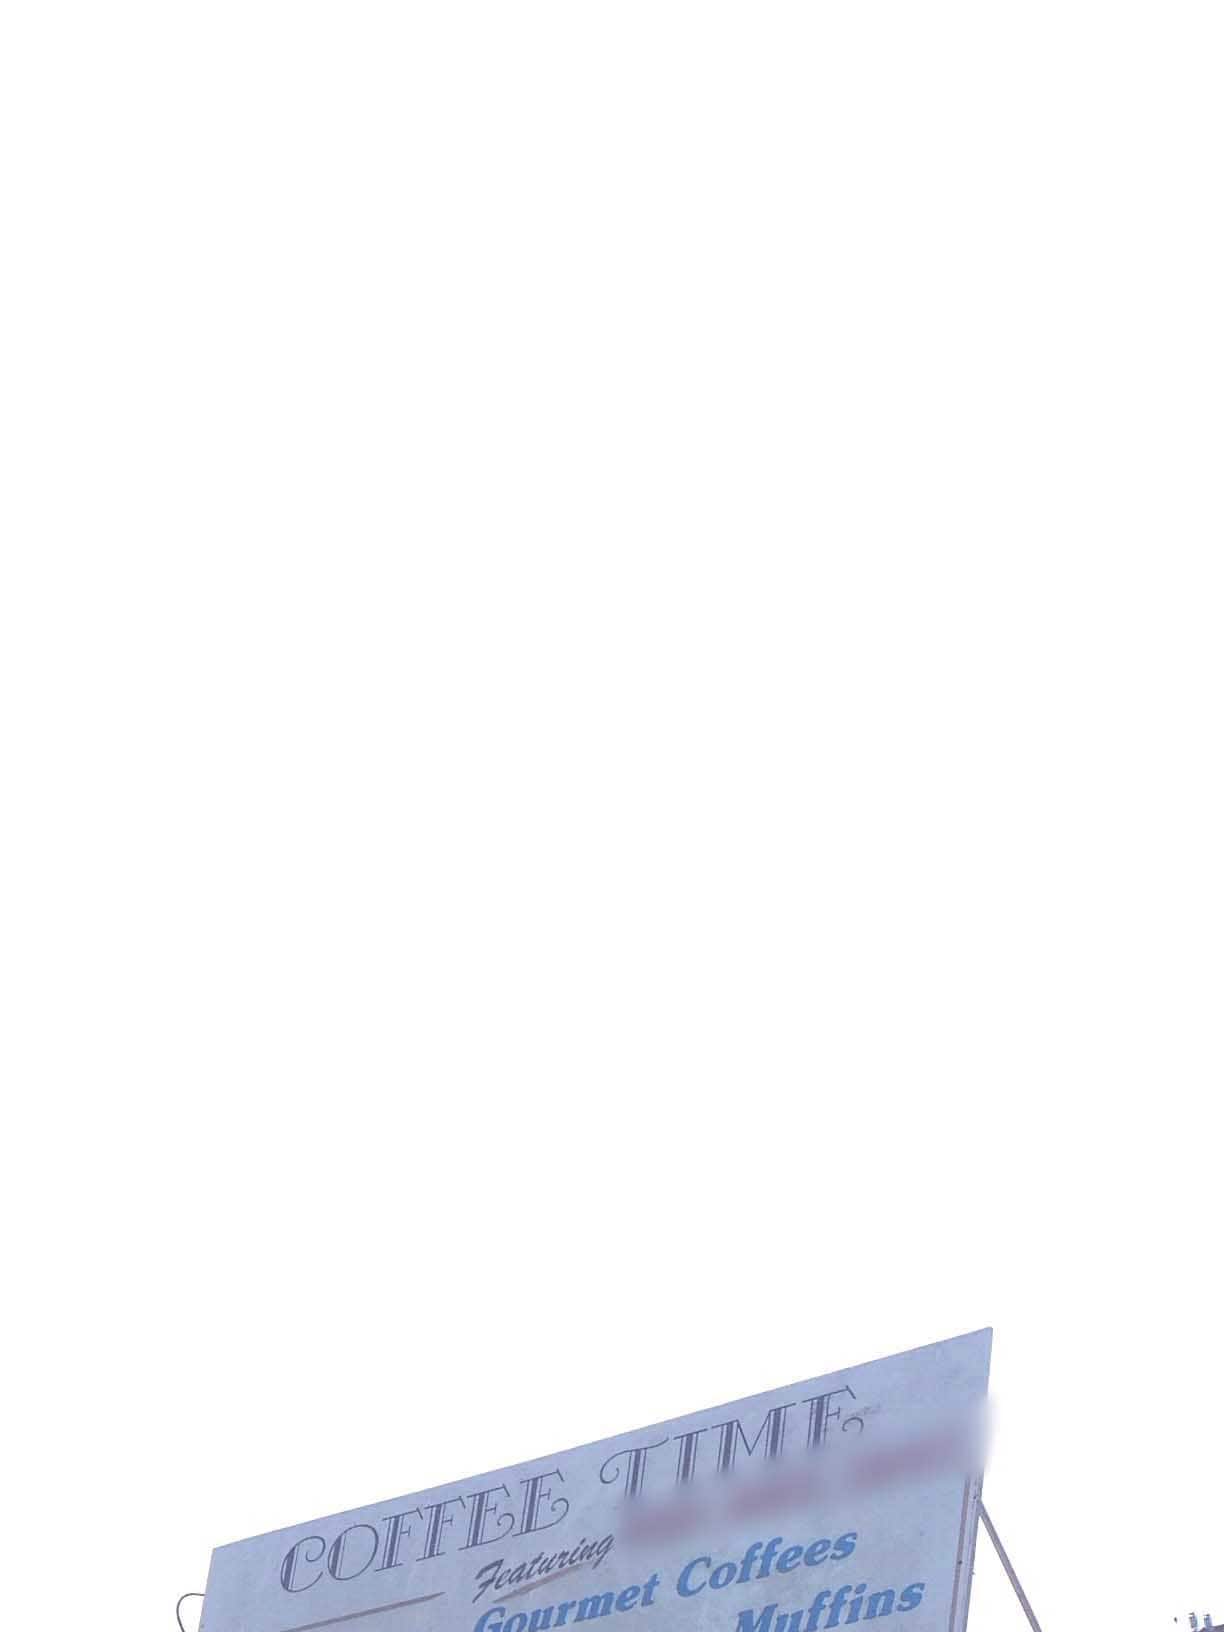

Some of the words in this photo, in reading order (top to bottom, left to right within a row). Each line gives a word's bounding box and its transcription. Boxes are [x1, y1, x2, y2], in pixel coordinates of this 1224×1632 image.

[280, 1469, 569, 1594] COFFEE
[599, 1385, 865, 1499] TIME
[473, 1531, 615, 1601] Featuring
[677, 1531, 858, 1598] Coffees
